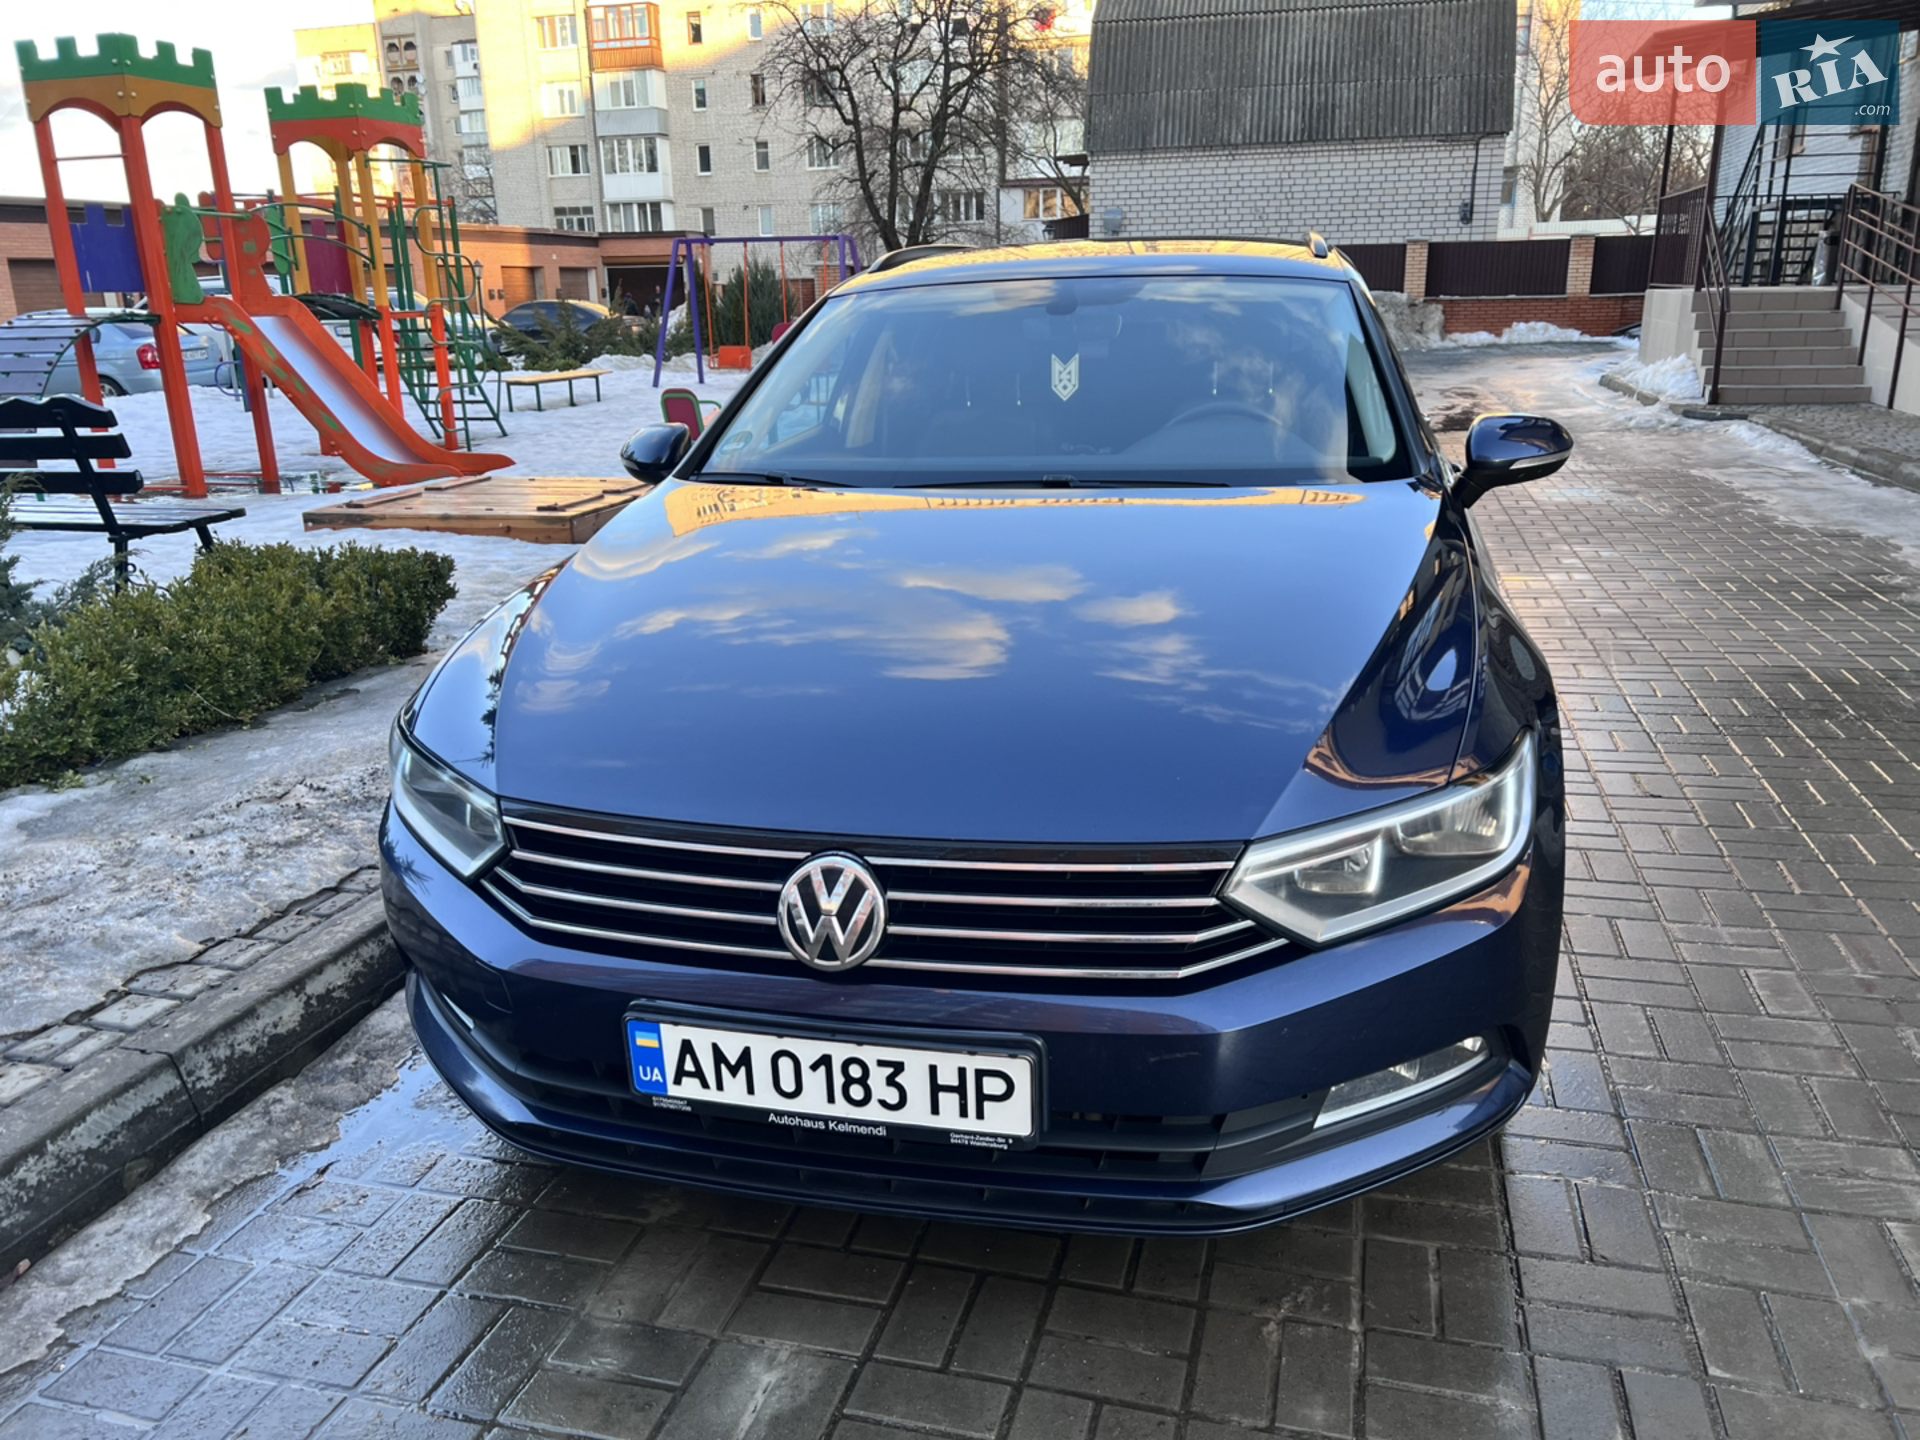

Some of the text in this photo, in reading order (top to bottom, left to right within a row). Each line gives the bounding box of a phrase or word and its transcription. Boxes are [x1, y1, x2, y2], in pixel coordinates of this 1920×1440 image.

[639, 1065, 664, 1083] UA
[672, 1038, 1016, 1121] AM 0183 HP
[768, 1112, 887, 1137] Autohaus Kelmendi
